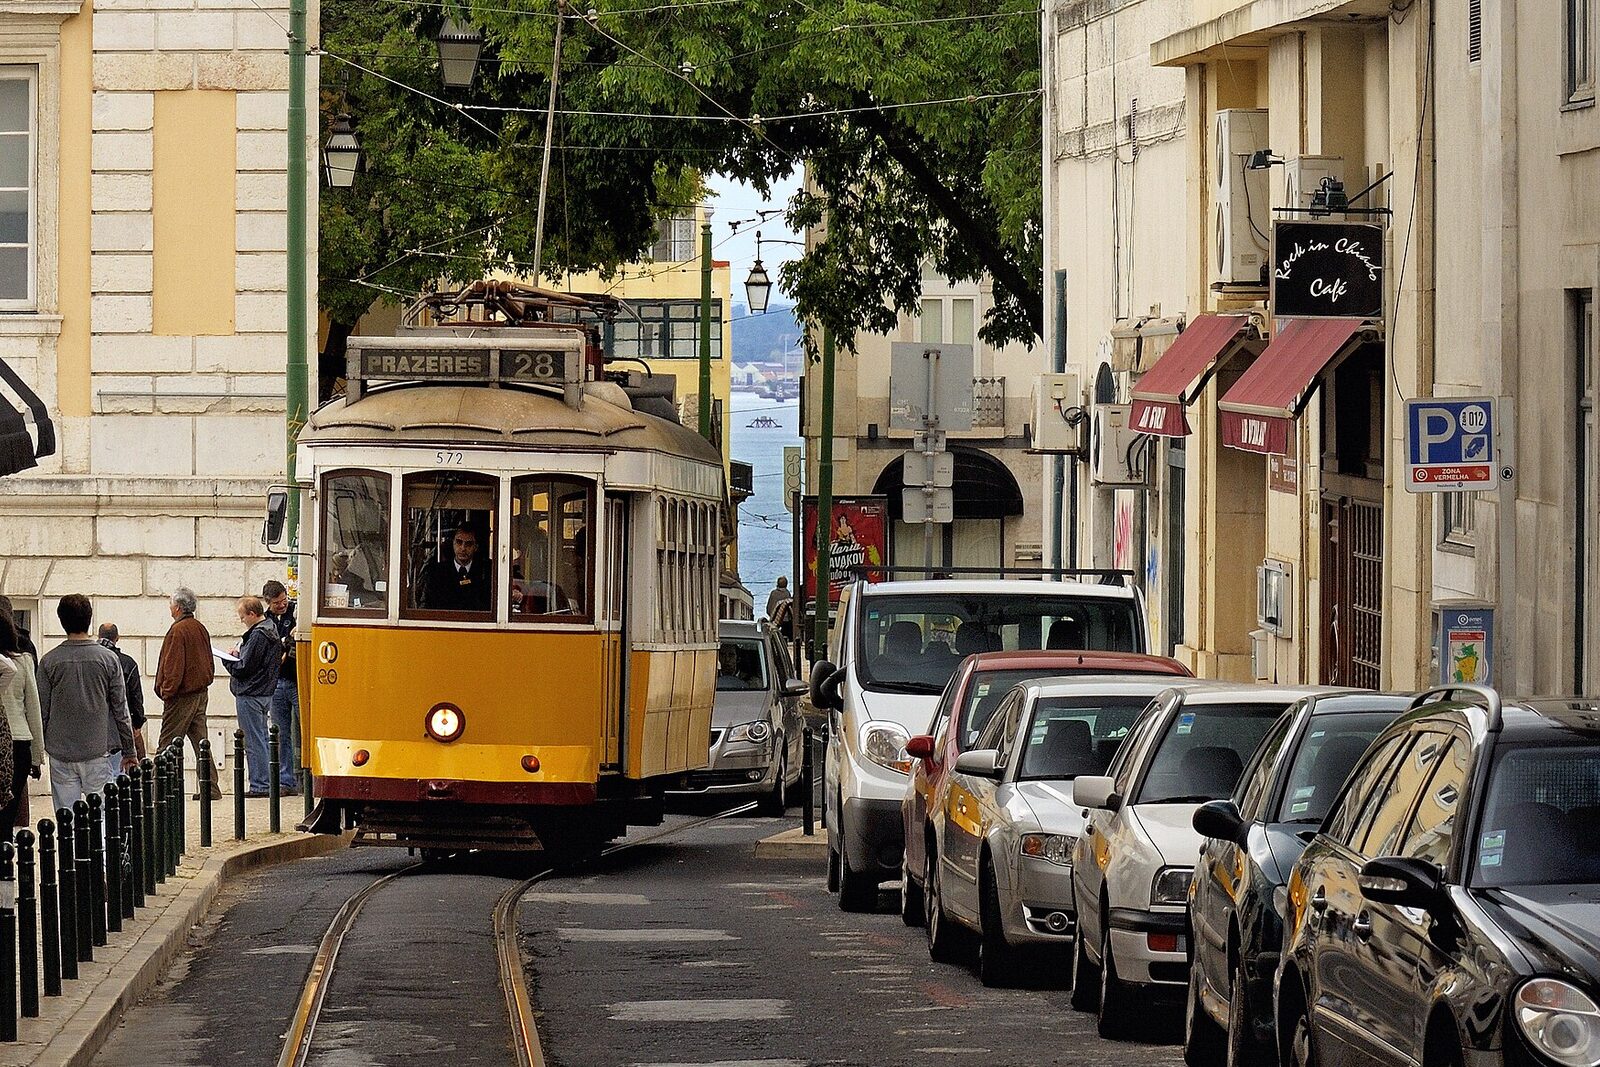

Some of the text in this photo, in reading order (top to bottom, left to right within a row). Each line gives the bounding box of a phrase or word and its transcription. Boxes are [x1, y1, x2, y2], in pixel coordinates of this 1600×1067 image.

[1275, 238, 1382, 281] Rock in Chiado
[1310, 278, 1347, 303] Café
[367, 355, 482, 373] PRAZERES
[514, 352, 554, 378] 28
[1468, 411, 1484, 427] 012
[1418, 407, 1457, 464] P
[436, 452, 464, 465] 572
